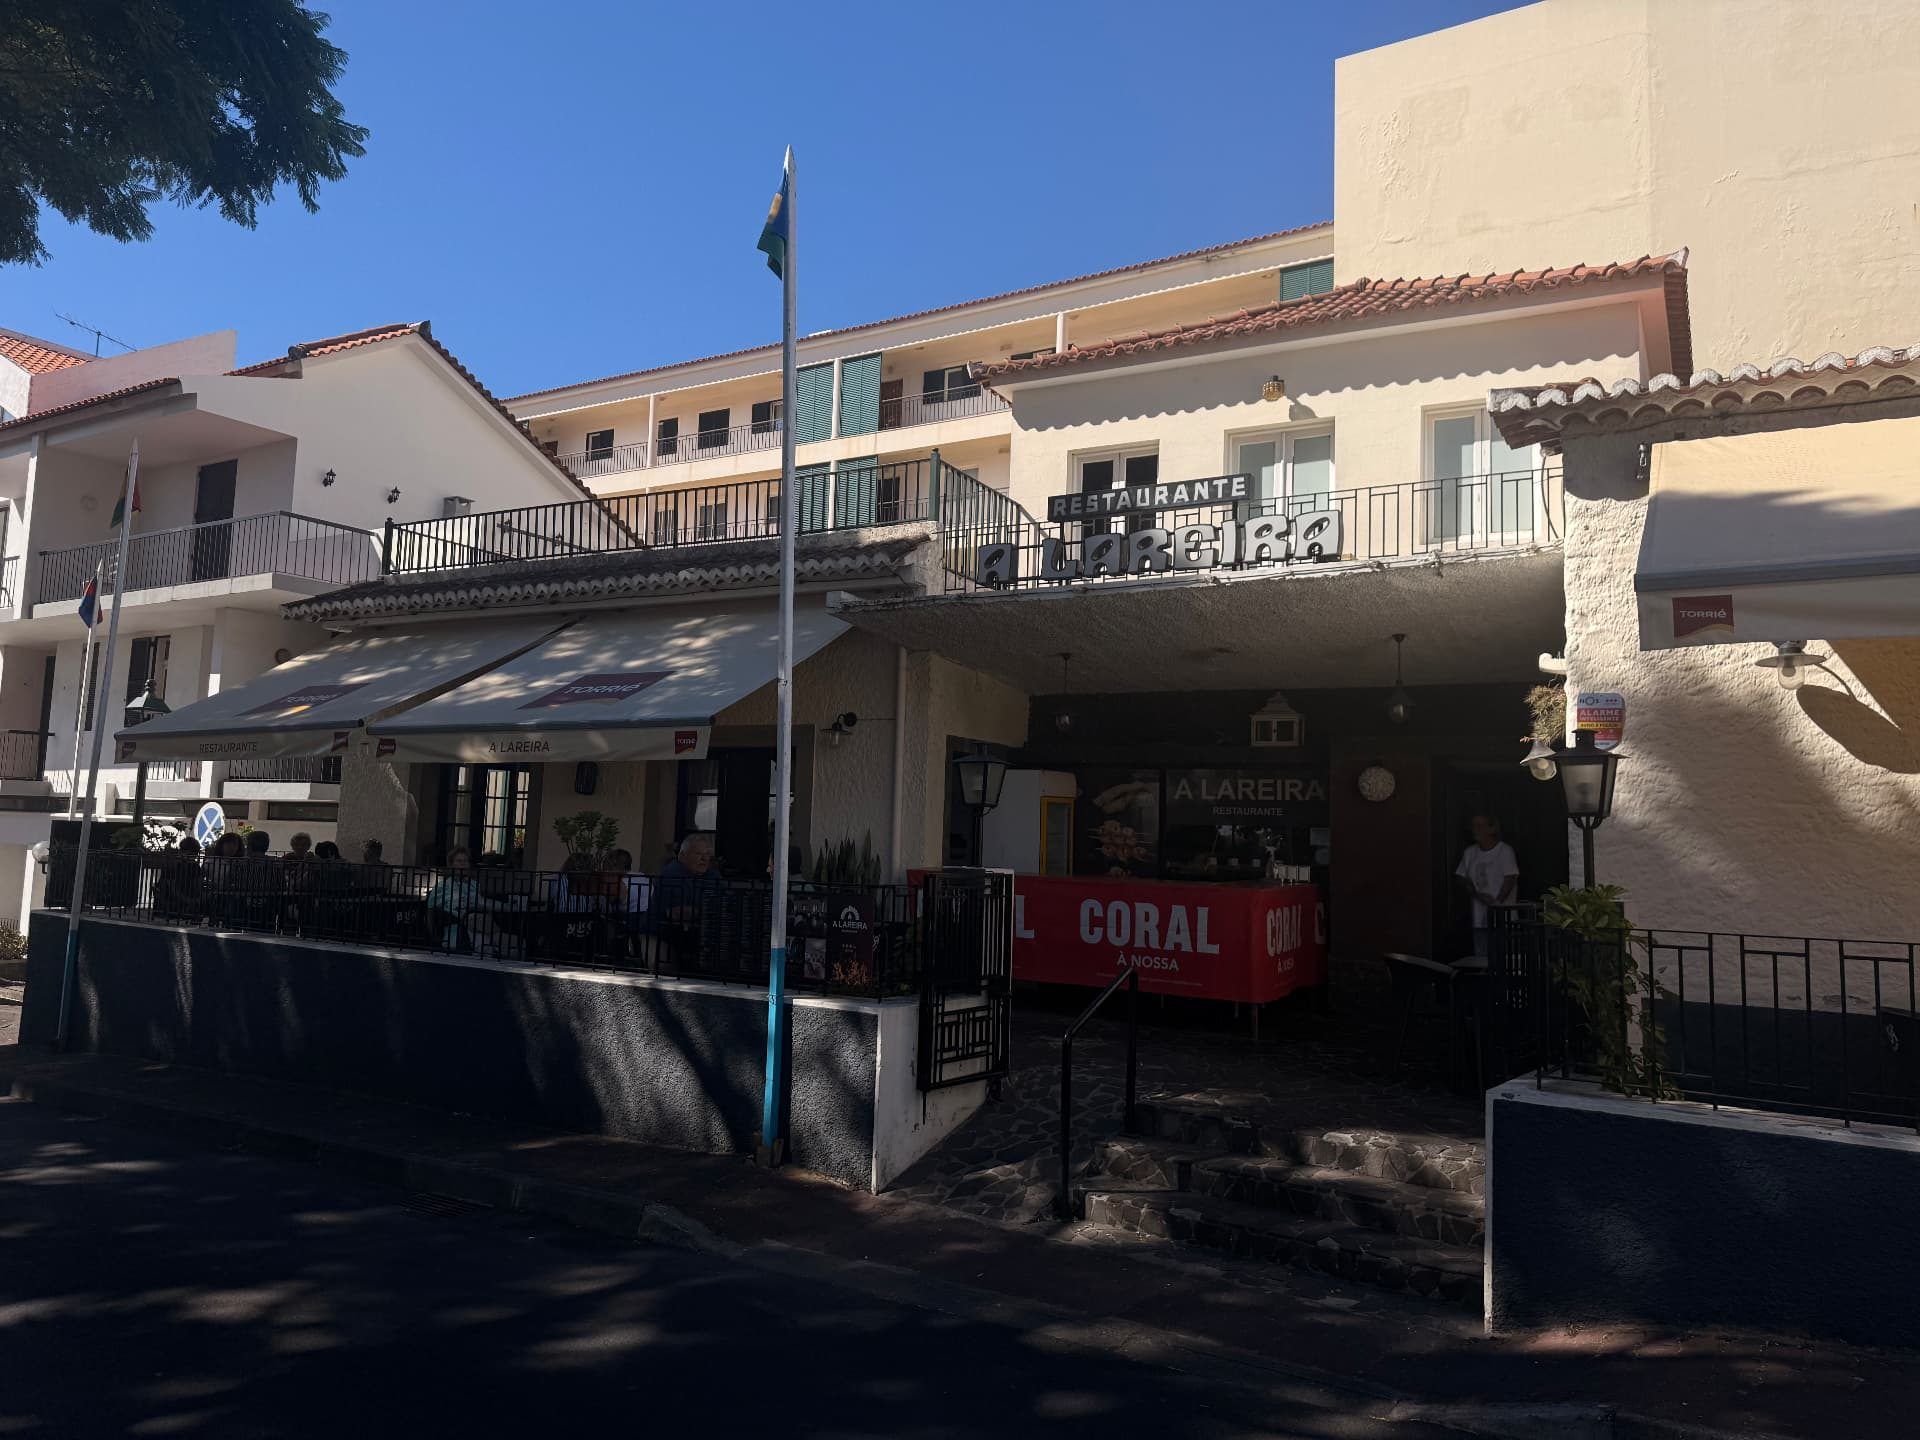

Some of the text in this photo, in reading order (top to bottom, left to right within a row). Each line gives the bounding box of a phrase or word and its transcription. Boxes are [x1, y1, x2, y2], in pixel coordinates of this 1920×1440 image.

[1051, 476, 1247, 516] RESTAURANTE
[1040, 510, 1344, 580] LAREIRA
[1679, 608, 1727, 618] TORRIÉ
[199, 741, 257, 753] RESTAURANTE
[489, 741, 551, 753] A LAREIRA
[1174, 778, 1326, 801] A LAREIRA
[1212, 806, 1286, 816] RESTAURANTE
[1079, 898, 1221, 955] CORAL
[1116, 951, 1180, 972] À NOSSA
